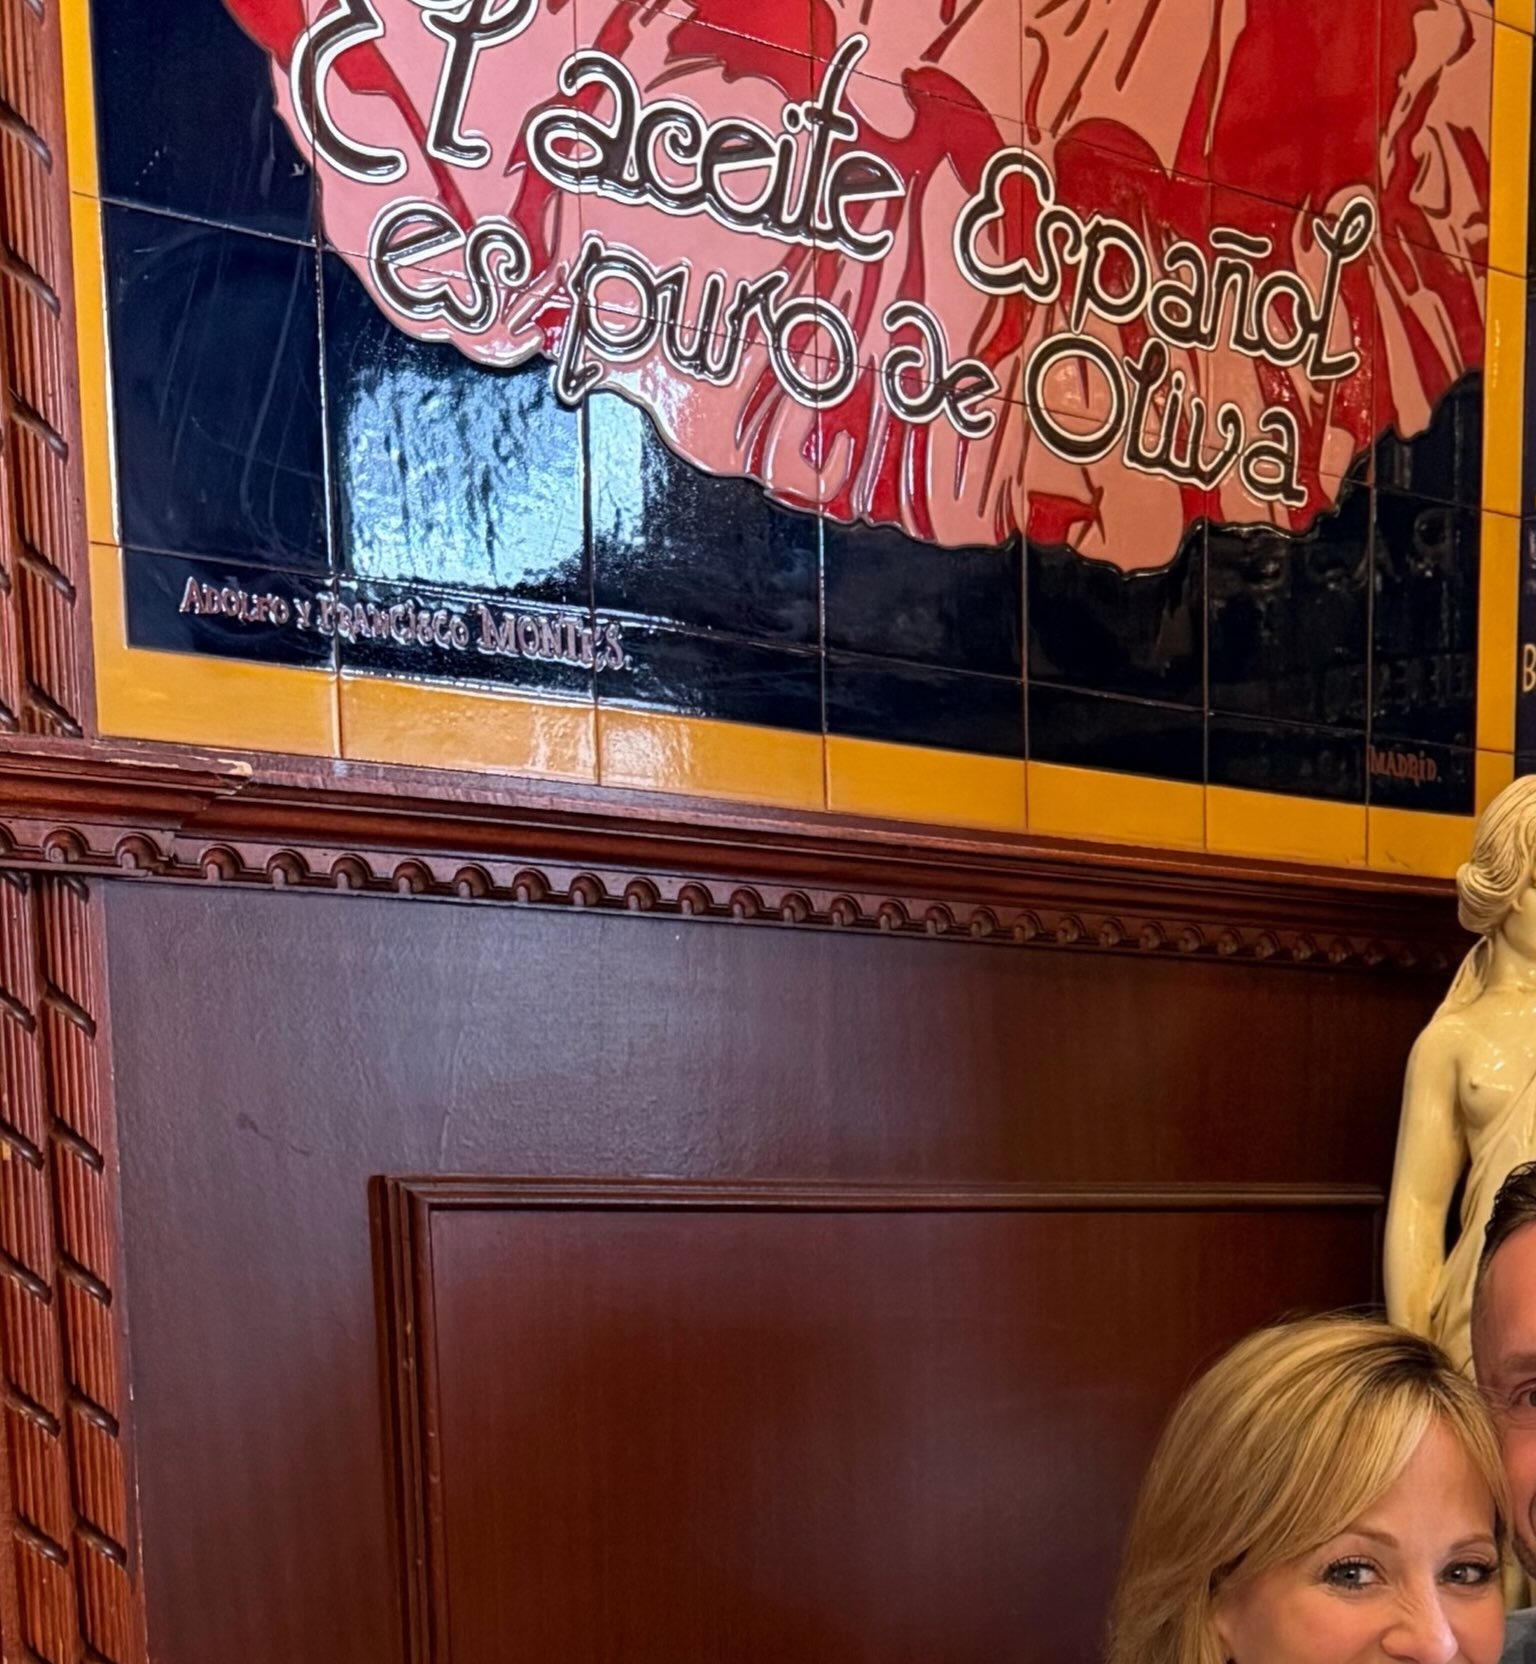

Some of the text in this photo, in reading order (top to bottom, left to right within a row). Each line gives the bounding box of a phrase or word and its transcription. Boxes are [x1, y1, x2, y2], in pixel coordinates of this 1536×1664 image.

[369, 198, 1308, 508] es puro de Oliva
[526, 33, 905, 262] aceite
[953, 146, 1374, 379] Español
[179, 576, 289, 625] ADOLFO
[316, 591, 471, 648] FRANCISCO
